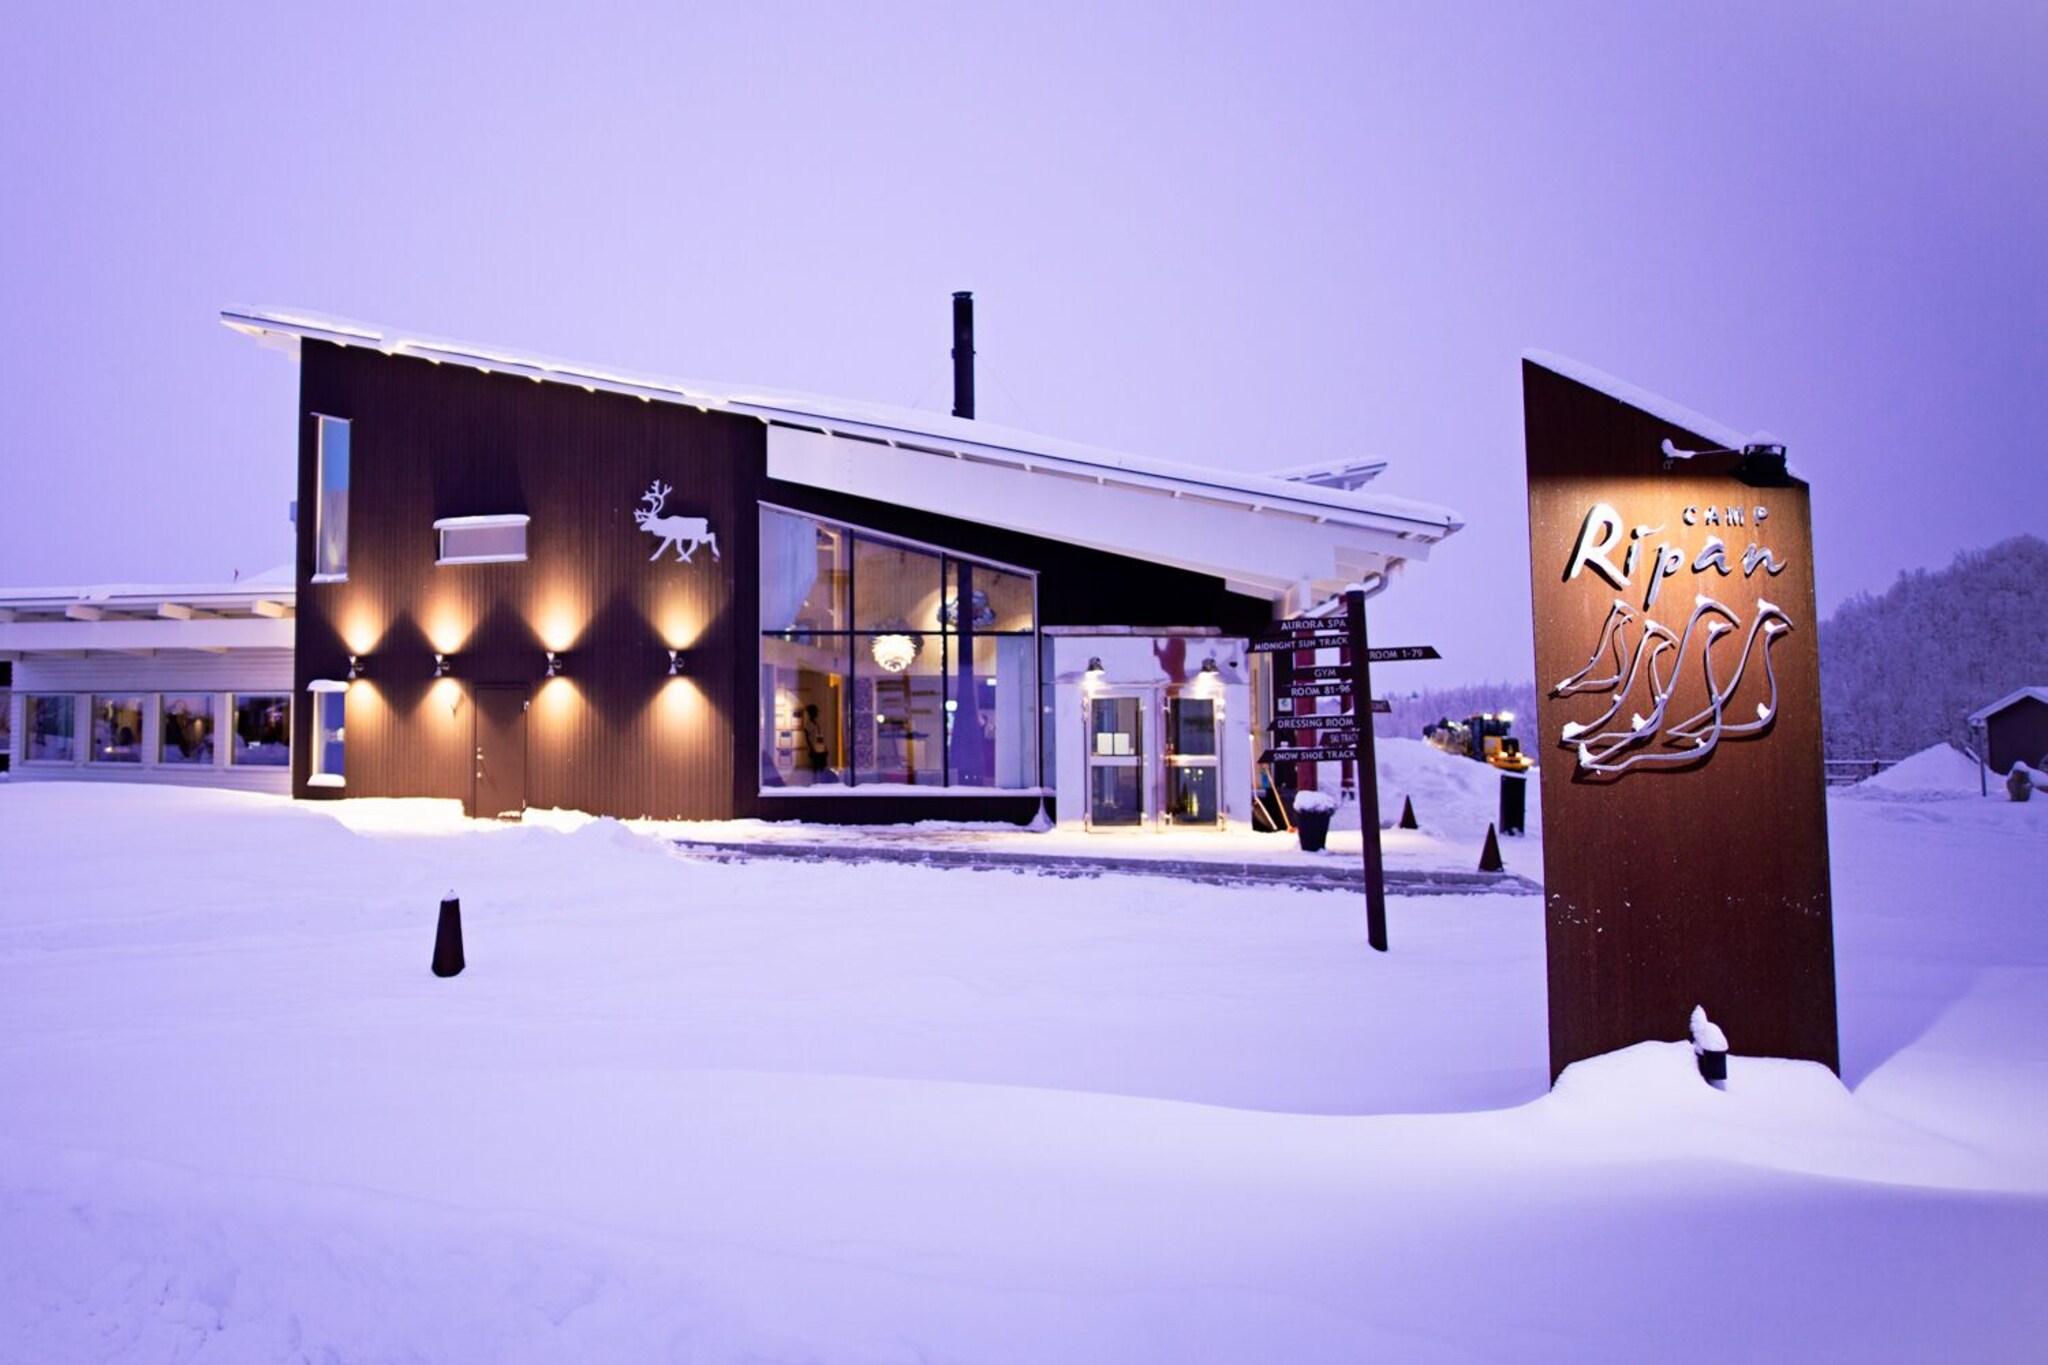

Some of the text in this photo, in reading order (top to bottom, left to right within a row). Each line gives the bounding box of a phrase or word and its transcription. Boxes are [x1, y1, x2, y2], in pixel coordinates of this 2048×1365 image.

[1682, 504, 1769, 526] CAMP
[1563, 503, 1787, 611] Ripan
[1280, 618, 1347, 631] AURORA SPA
[1254, 636, 1349, 651] MIDNIGHT SUN TRACK
[1368, 648, 1424, 660] ROOM 1-79
[1313, 668, 1337, 678] GYM
[1290, 684, 1351, 697] ROOM 81-96
[1277, 717, 1354, 729] DRESSING ROOM
[1341, 733, 1360, 742] TRAC
[1273, 749, 1356, 761] SNOW SHOE TRACK
